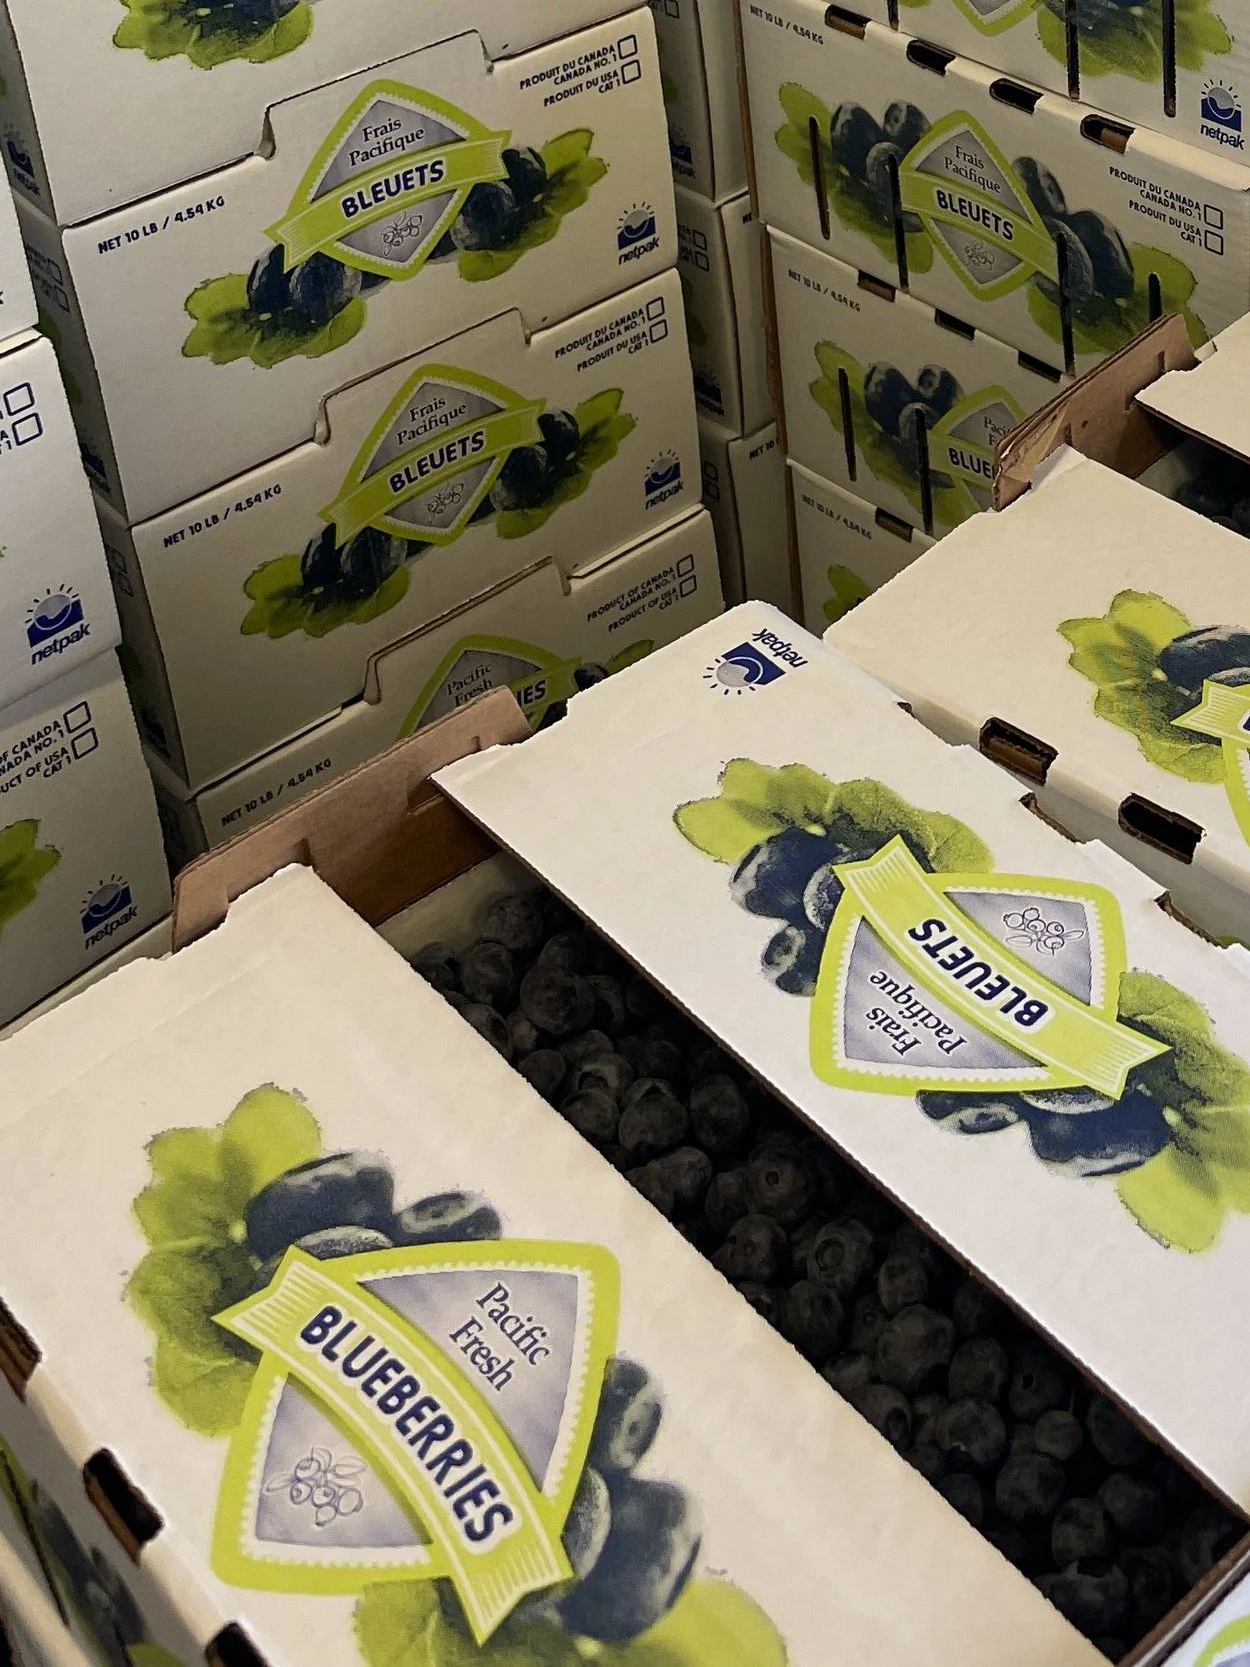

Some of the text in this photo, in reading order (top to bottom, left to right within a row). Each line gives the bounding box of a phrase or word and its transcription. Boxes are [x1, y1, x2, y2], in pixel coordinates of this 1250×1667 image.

[349, 126, 424, 166] Pacifique
[362, 118, 401, 144] Frais
[1201, 125, 1244, 150] netpak
[945, 154, 1000, 193] Pacifique
[956, 145, 984, 169] Frais
[342, 160, 443, 219] BLEUETS
[937, 190, 1013, 240] BLEUETS
[619, 237, 659, 265] netpak
[397, 402, 466, 445] Pacifique
[410, 398, 449, 426] Frais
[390, 430, 486, 492] BLEUETS
[645, 480, 683, 510] netpak
[32, 624, 90, 665] netpak
[752, 629, 808, 667] netpak
[908, 919, 1048, 1029] BLEUETS
[866, 1008, 921, 1055] Frais
[869, 972, 967, 1055] Pacifique
[476, 1282, 549, 1365] Pacific
[449, 1316, 515, 1391] Fresh
[300, 1303, 514, 1546] BLUEBERRIES
